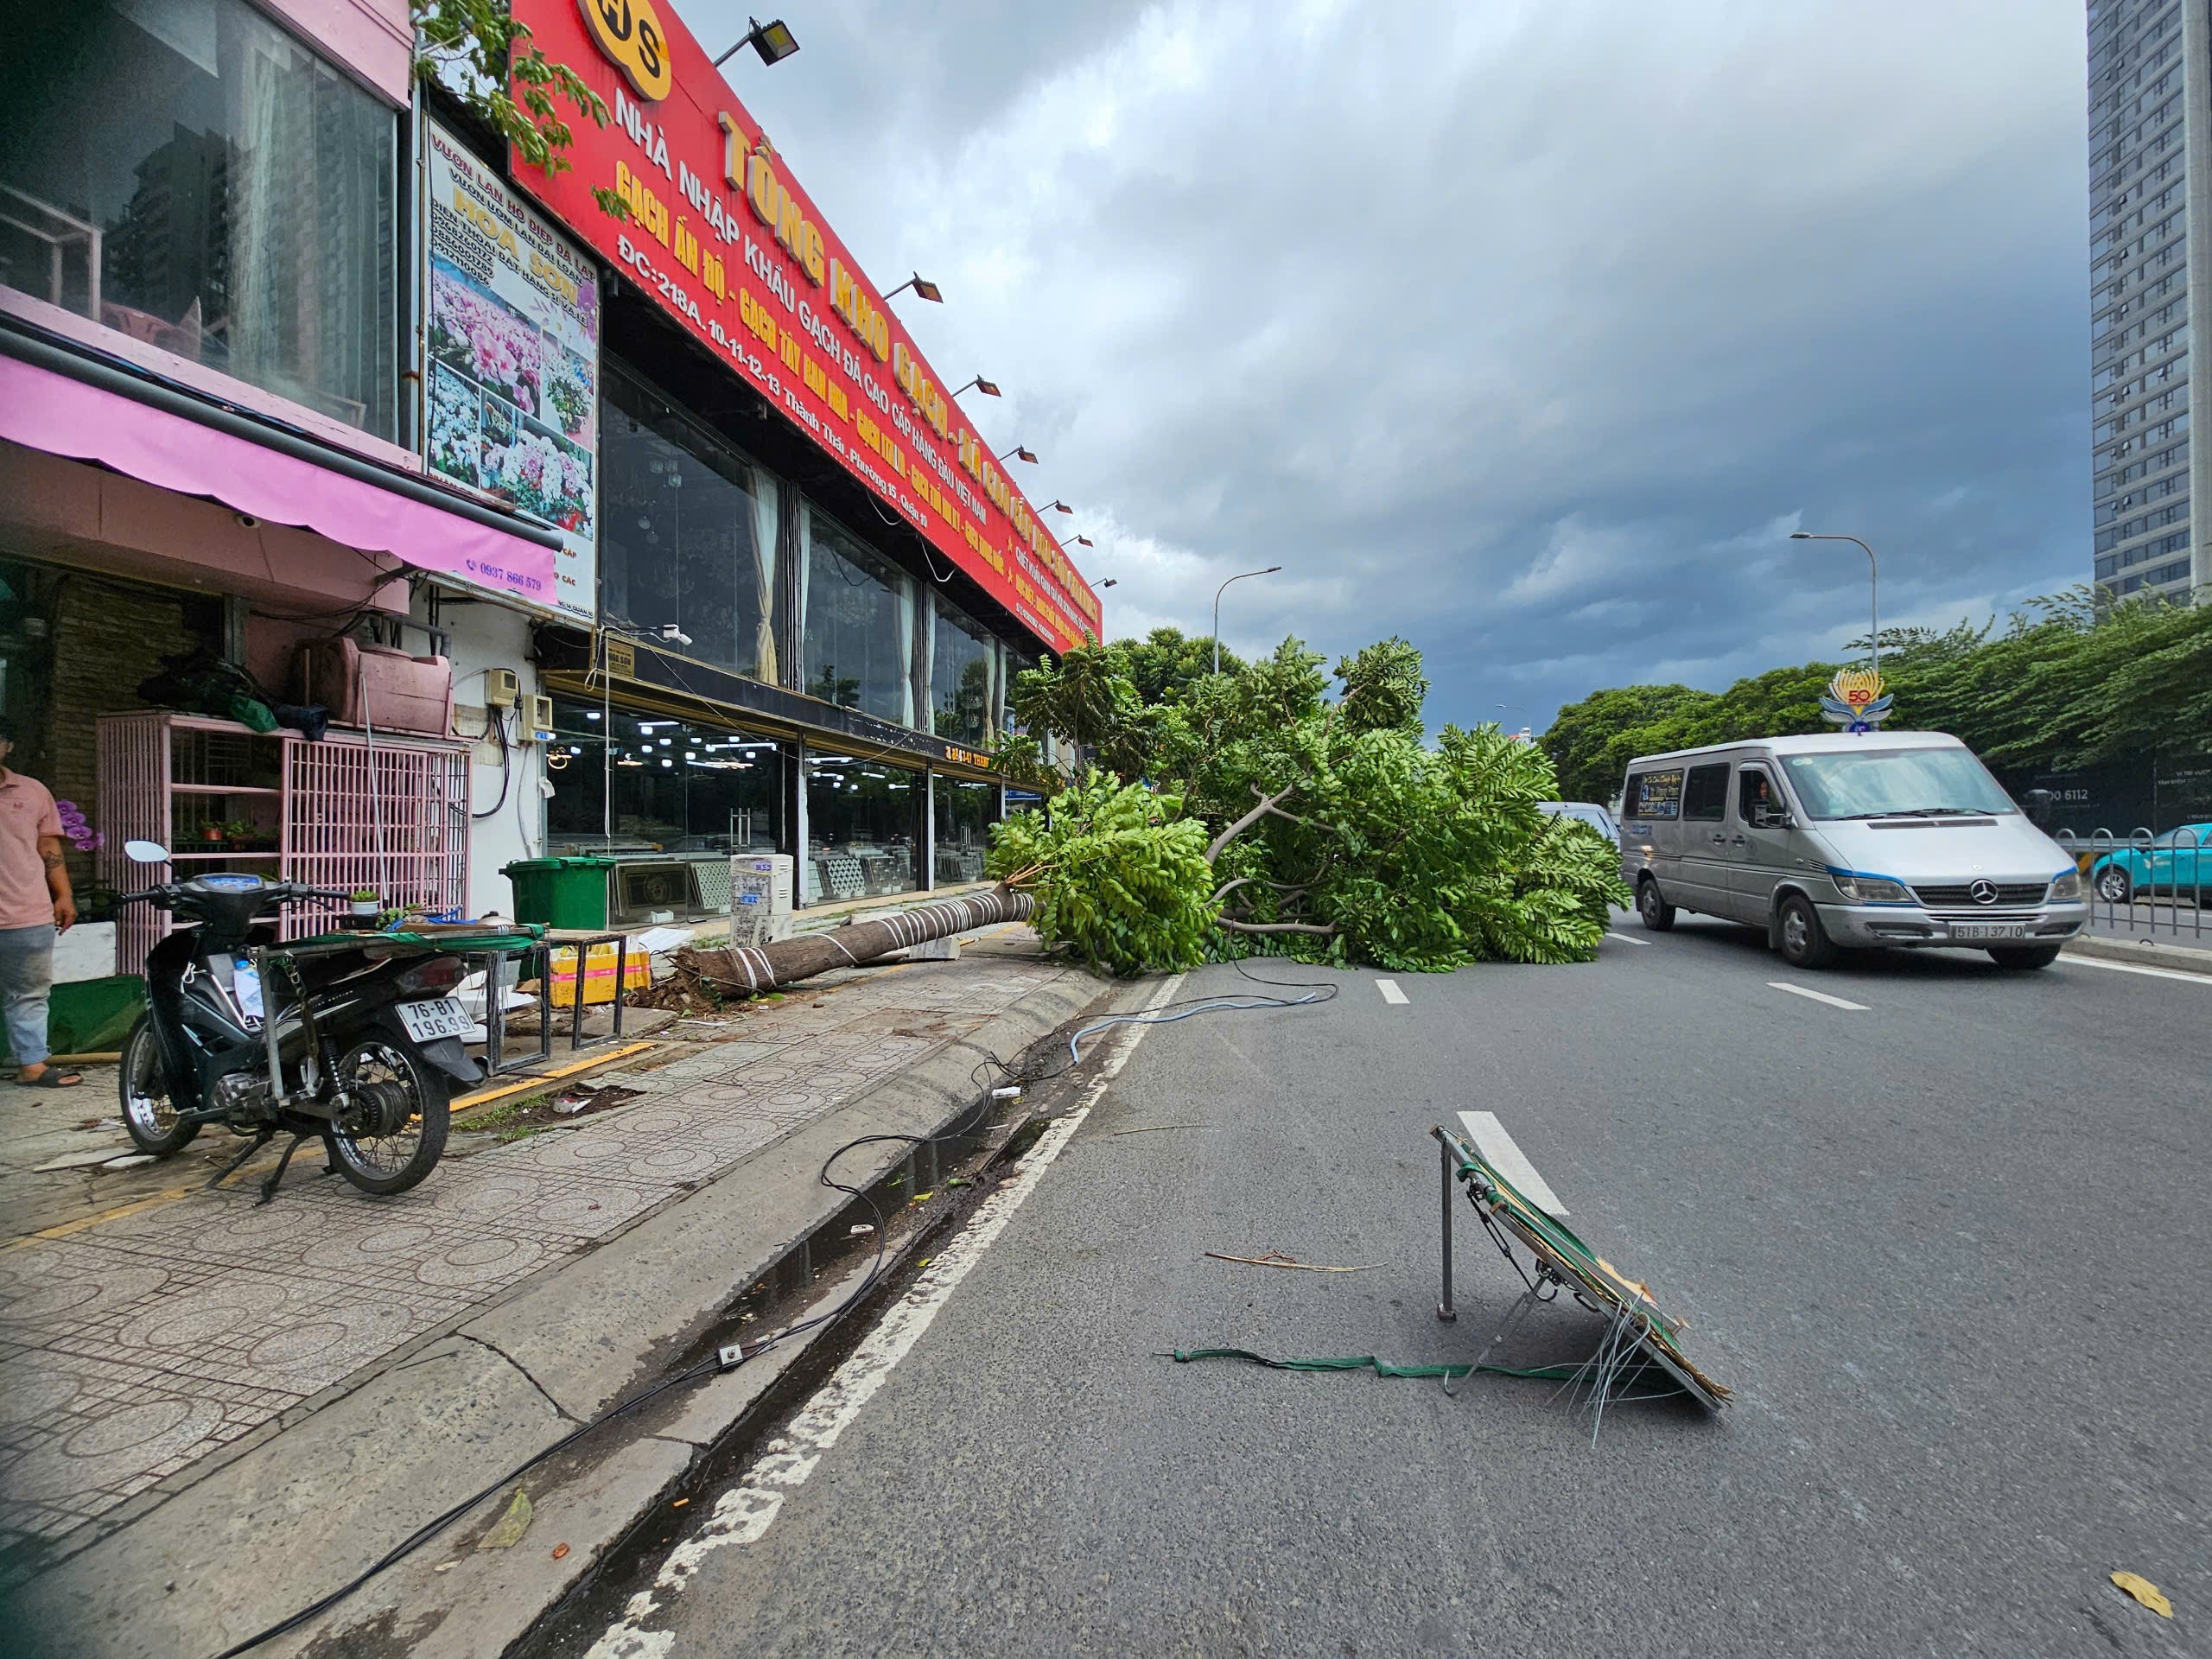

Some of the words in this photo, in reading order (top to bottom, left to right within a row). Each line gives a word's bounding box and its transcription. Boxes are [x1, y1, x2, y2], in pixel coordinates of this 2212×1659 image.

[476, 173, 503, 205] LAN
[454, 188, 519, 261] HOA
[515, 223, 535, 248] LAN
[557, 258, 583, 287] LOAN
[718, 110, 824, 288] TỔNG
[830, 257, 889, 363] KHO
[893, 342, 948, 441] GẠCH
[616, 160, 669, 249] GẠCH
[674, 215, 698, 276] ẤN
[702, 249, 725, 306] ĐỘ
[740, 288, 776, 353] GẠCH
[779, 328, 801, 377] TÂY
[803, 353, 826, 403] BAN
[615, 87, 672, 181] NHÀ
[679, 160, 740, 245] NHẬP
[798, 300, 841, 365] GẠCH
[843, 349, 862, 389] ĐÁ
[864, 372, 889, 415] CAO
[892, 404, 911, 437] CẤP
[912, 423, 938, 470] HÀNG
[956, 475, 972, 508] VIỆT
[971, 493, 987, 526] NAM
[783, 386, 819, 433] Thành
[850, 448, 887, 495] Phường
[887, 482, 897, 499] 15
[900, 493, 918, 521] Quận
[480, 563, 504, 580] 0937
[506, 570, 524, 586] 866
[525, 576, 542, 591] 579
[1848, 689, 1871, 702] 50
[2064, 789, 2088, 801] 6112
[407, 999, 455, 1020] 76-B1
[412, 1015, 470, 1039] 196.99
